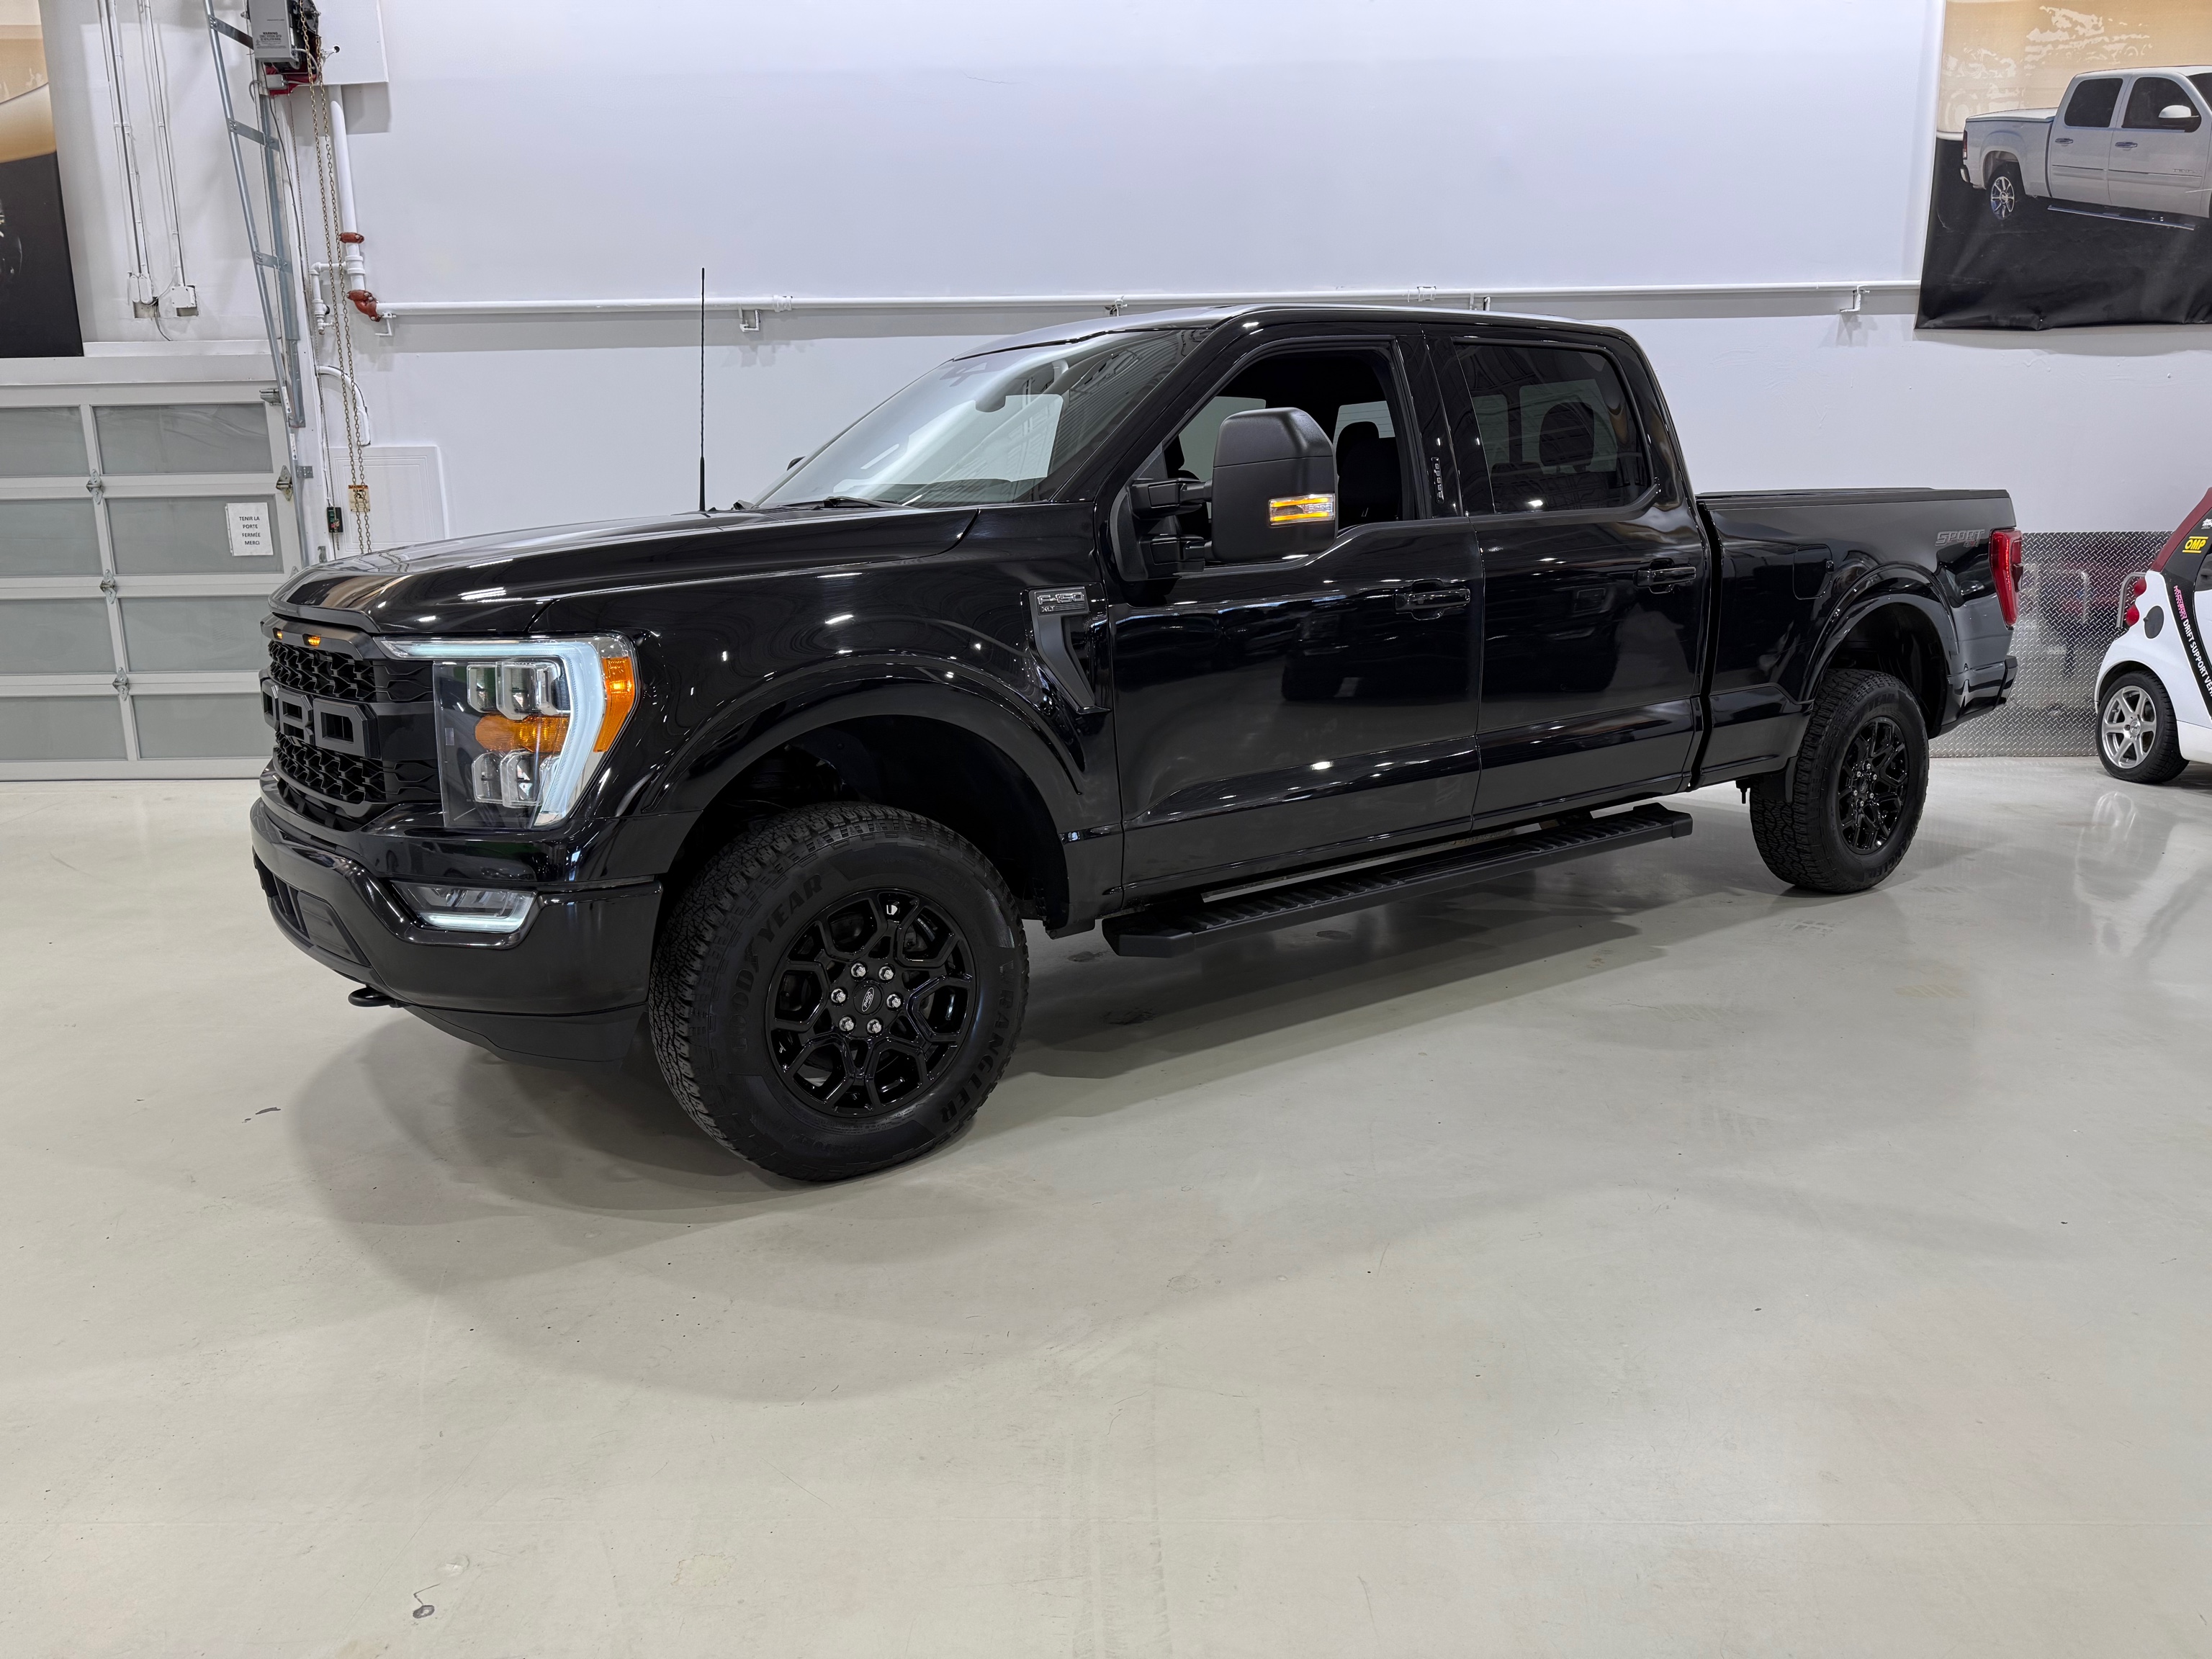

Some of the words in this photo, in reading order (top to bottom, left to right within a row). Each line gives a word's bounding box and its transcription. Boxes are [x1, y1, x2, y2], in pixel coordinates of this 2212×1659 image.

[1935, 529, 1985, 547] SPORT
[2185, 539, 2207, 550] OMP
[2182, 619, 2195, 642] DRIFT
[2190, 642, 2208, 678] SUPPORT
